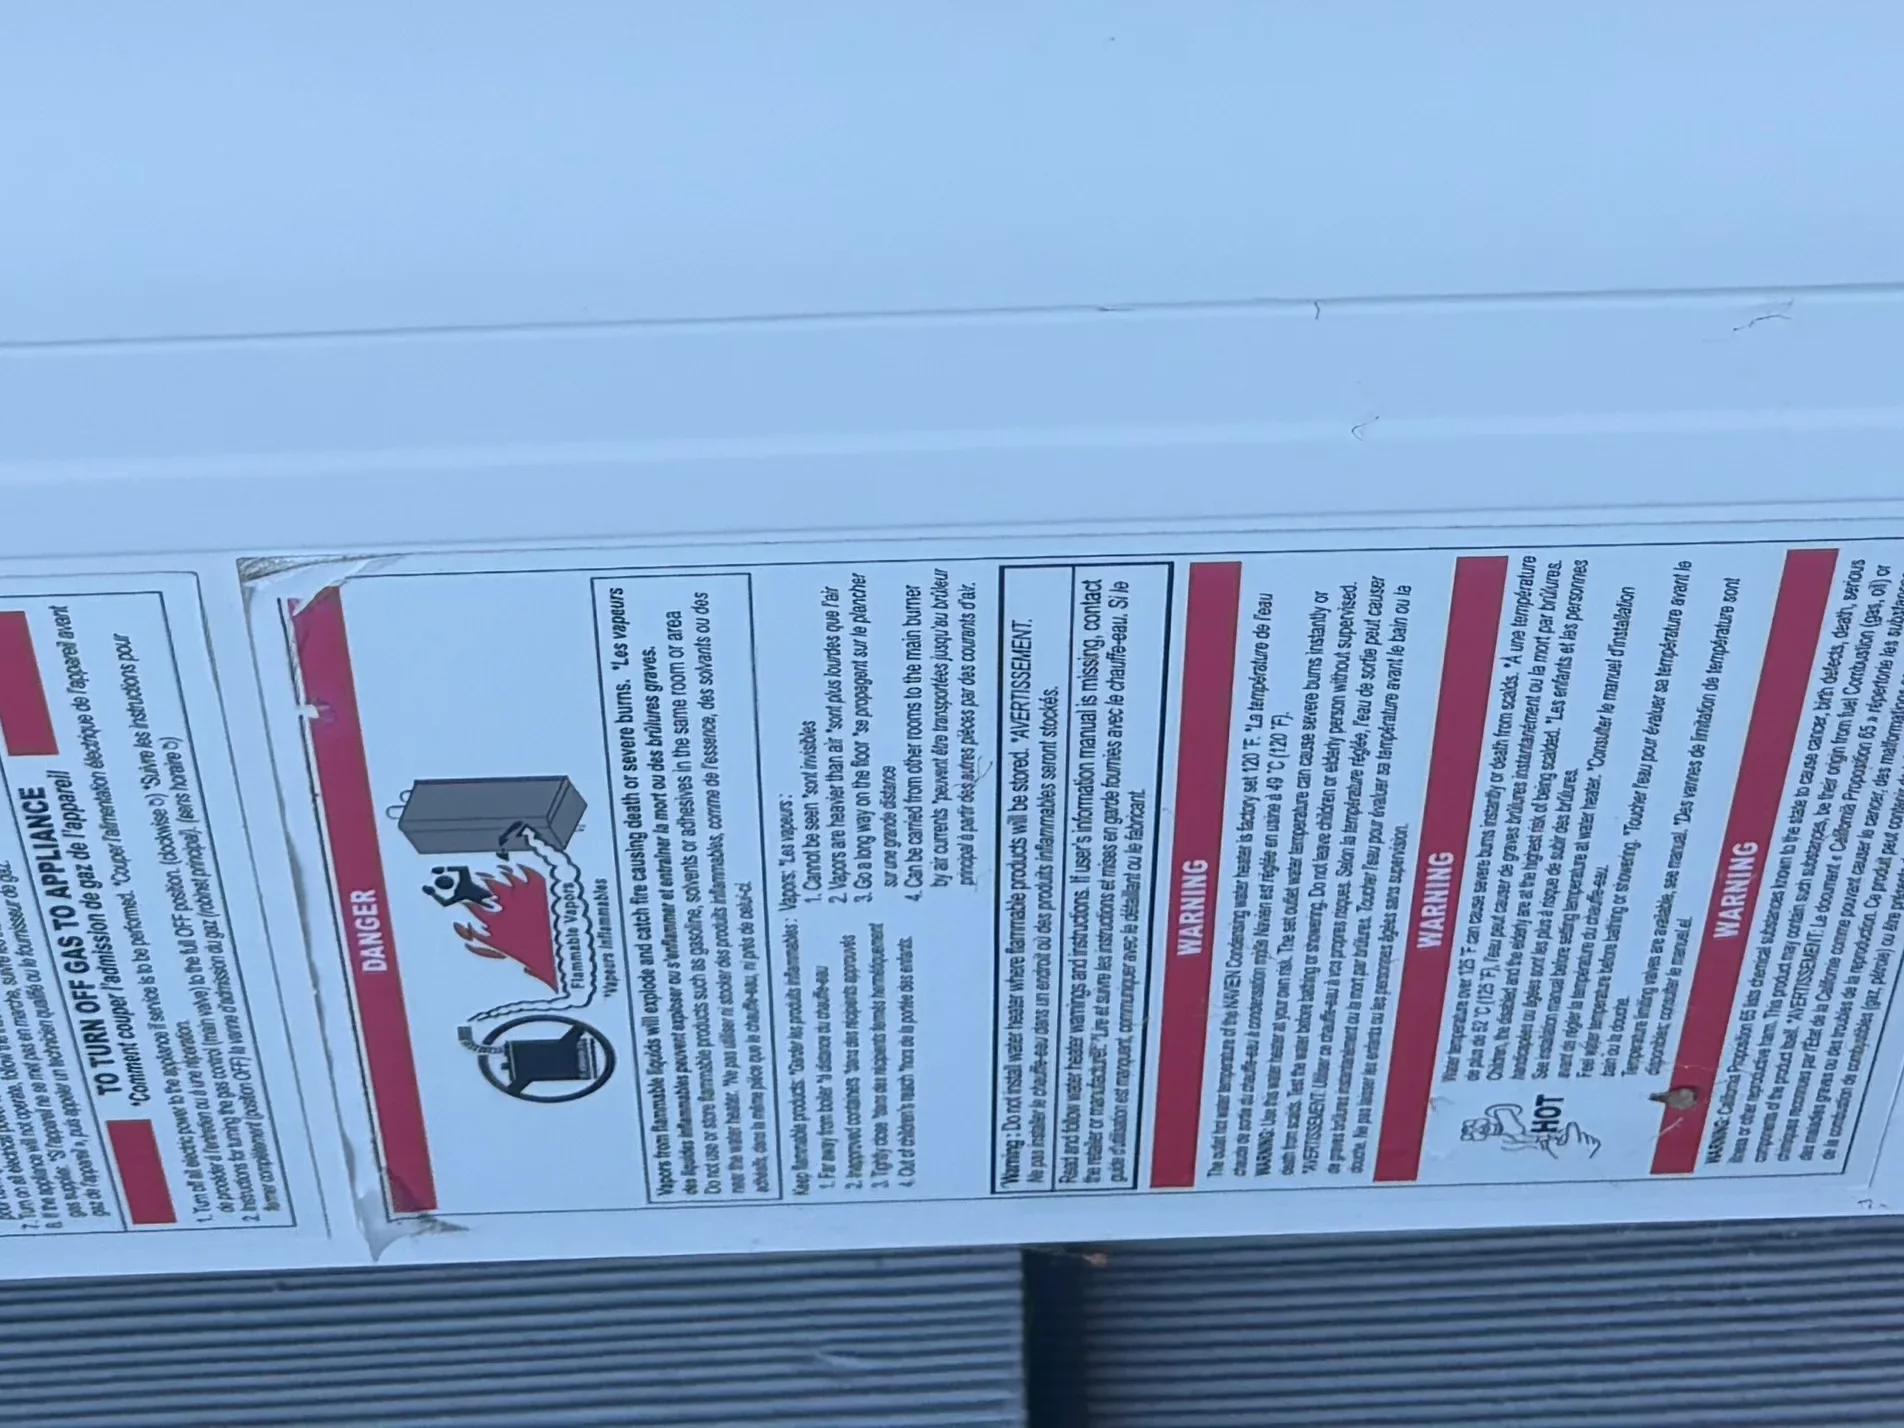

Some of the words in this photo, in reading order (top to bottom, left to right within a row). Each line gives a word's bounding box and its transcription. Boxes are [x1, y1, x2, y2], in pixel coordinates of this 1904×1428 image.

[608, 586, 630, 639] vapeurs
[819, 585, 839, 608] l'air
[902, 583, 922, 627] burner
[1252, 592, 1273, 621] l'eau
[824, 609, 844, 632] que
[1251, 623, 1271, 639] de
[822, 634, 842, 678] lourdes
[901, 629, 921, 661] main
[824, 678, 845, 704] plus
[901, 663, 922, 684] the
[614, 678, 634, 723] burns.
[902, 686, 922, 699] to
[905, 701, 922, 740] rooms
[618, 726, 638, 772] severe
[798, 719, 817, 770] invisibles
[822, 735, 843, 753] air
[902, 742, 923, 774] other
[1240, 751, 1260, 773] 120
[622, 773, 639, 789] or
[824, 754, 844, 782] than
[1008, 747, 1030, 792] stored.
[45, 769, 86, 839] l'appareil
[825, 783, 845, 828] heavier
[902, 775, 923, 804] from
[1006, 794, 1028, 812] be
[620, 791, 642, 829] death
[803, 801, 820, 831] seen
[903, 805, 923, 845] carried
[1006, 813, 1028, 835] will
[1235, 794, 1259, 832] factory
[17, 786, 72, 899] APPLIANCE
[65, 841, 91, 861] de
[625, 831, 648, 882] causing
[800, 832, 821, 848] be
[830, 829, 846, 849] are
[903, 846, 923, 863] be
[74, 863, 102, 889] gaz
[801, 849, 822, 891] Cannot
[827, 850, 850, 891] Vapors
[903, 863, 923, 888] Can
[1006, 836, 1028, 890] products
[1233, 844, 1252, 878] heater
[77, 891, 103, 910] de
[561, 881, 578, 924] Vapors
[628, 883, 649, 905] fire
[1176, 858, 1208, 956] WARNING
[1232, 878, 1249, 908] water
[1415, 851, 1454, 948] WARNING
[1712, 841, 1758, 938] WARNING
[48, 904, 79, 931] TO
[349, 888, 387, 972] DANGER
[630, 906, 652, 941] catch
[1004, 891, 1026, 954] flammable
[56, 935, 90, 974] GAS
[85, 912, 123, 991] l'admission
[633, 942, 654, 966] and
[1224, 909, 1249, 968] Condensing
[564, 926, 585, 989] Flammable
[1005, 955, 1025, 992] where
[67, 979, 101, 1014] OFF
[636, 967, 660, 1014] explode
[106, 992, 136, 1039] couper
[640, 1015, 660, 1036] will
[1004, 992, 1024, 1030] heater
[78, 1018, 115, 1068] TURN
[643, 1037, 666, 1075] liquids
[1005, 1030, 1023, 1062] water
[92, 1071, 122, 1096] TO
[1002, 1063, 1023, 1095] install
[646, 1076, 669, 1132] flammable
[1529, 1093, 1564, 1133] HOT
[652, 1133, 671, 1159] from
[655, 1159, 675, 1197] Vapors
